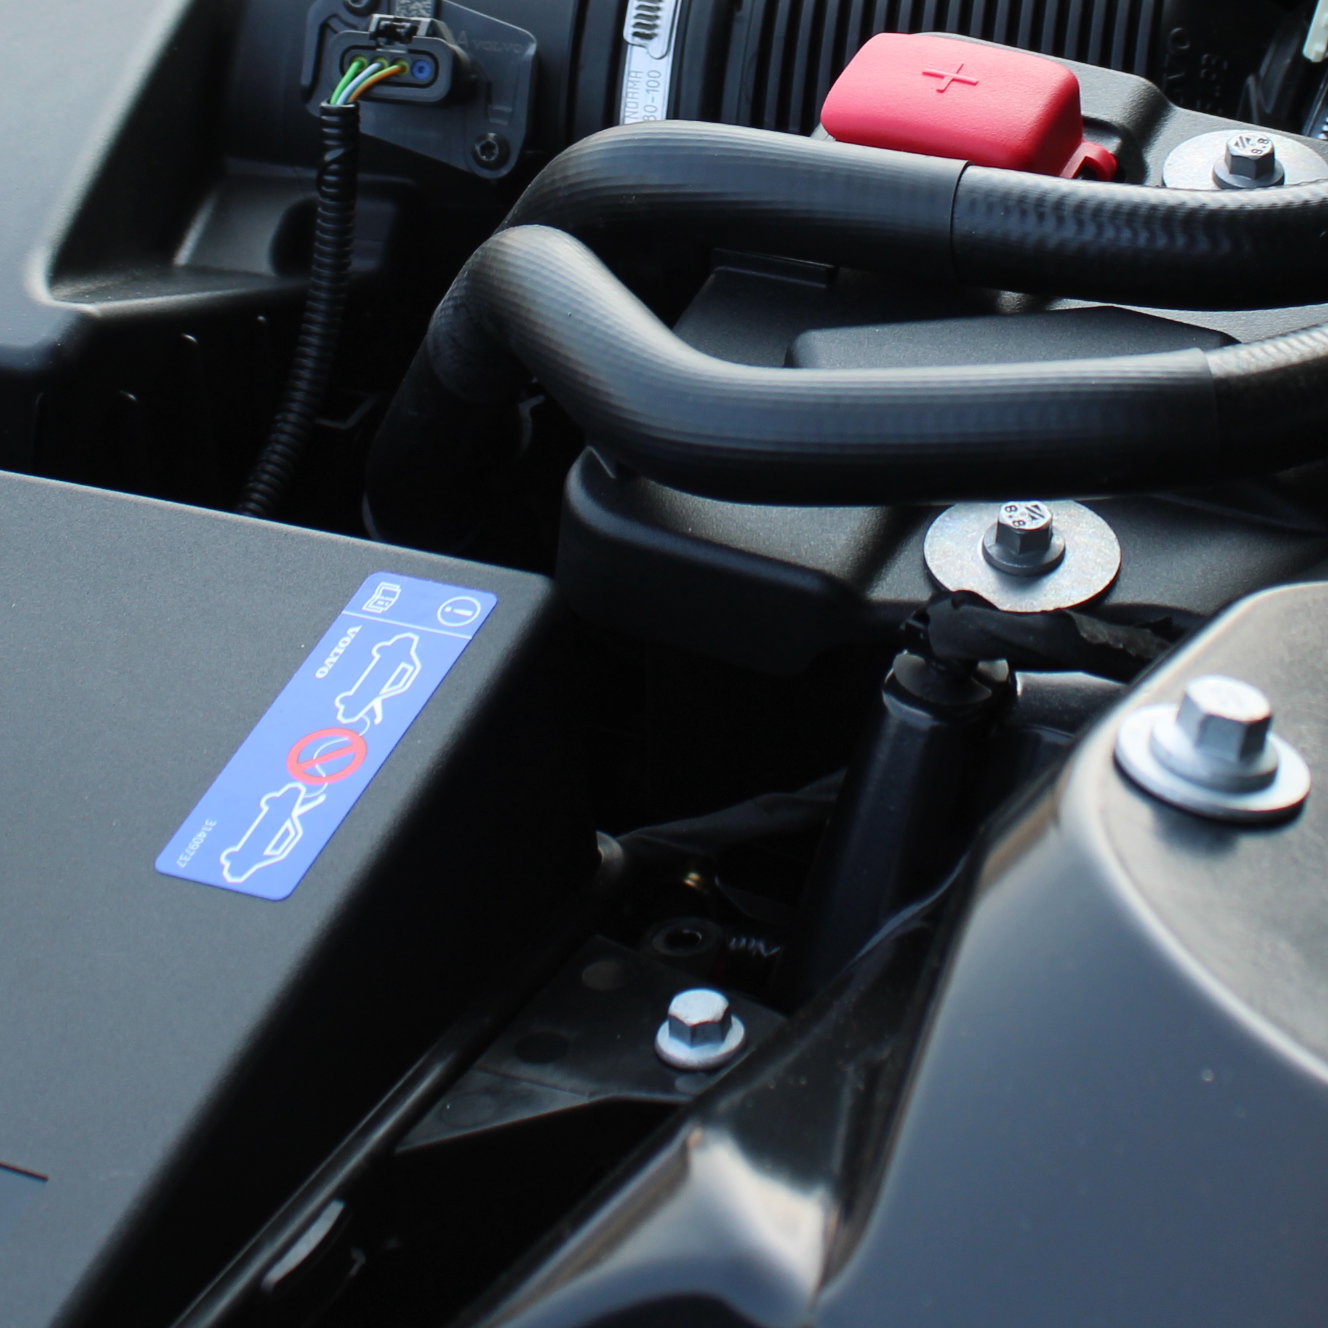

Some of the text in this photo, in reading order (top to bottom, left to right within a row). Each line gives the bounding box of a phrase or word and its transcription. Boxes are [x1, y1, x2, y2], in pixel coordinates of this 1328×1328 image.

[470, 38, 524, 55] VOLVO
[624, 69, 643, 120] NORMA
[315, 625, 362, 678] VOLVO
